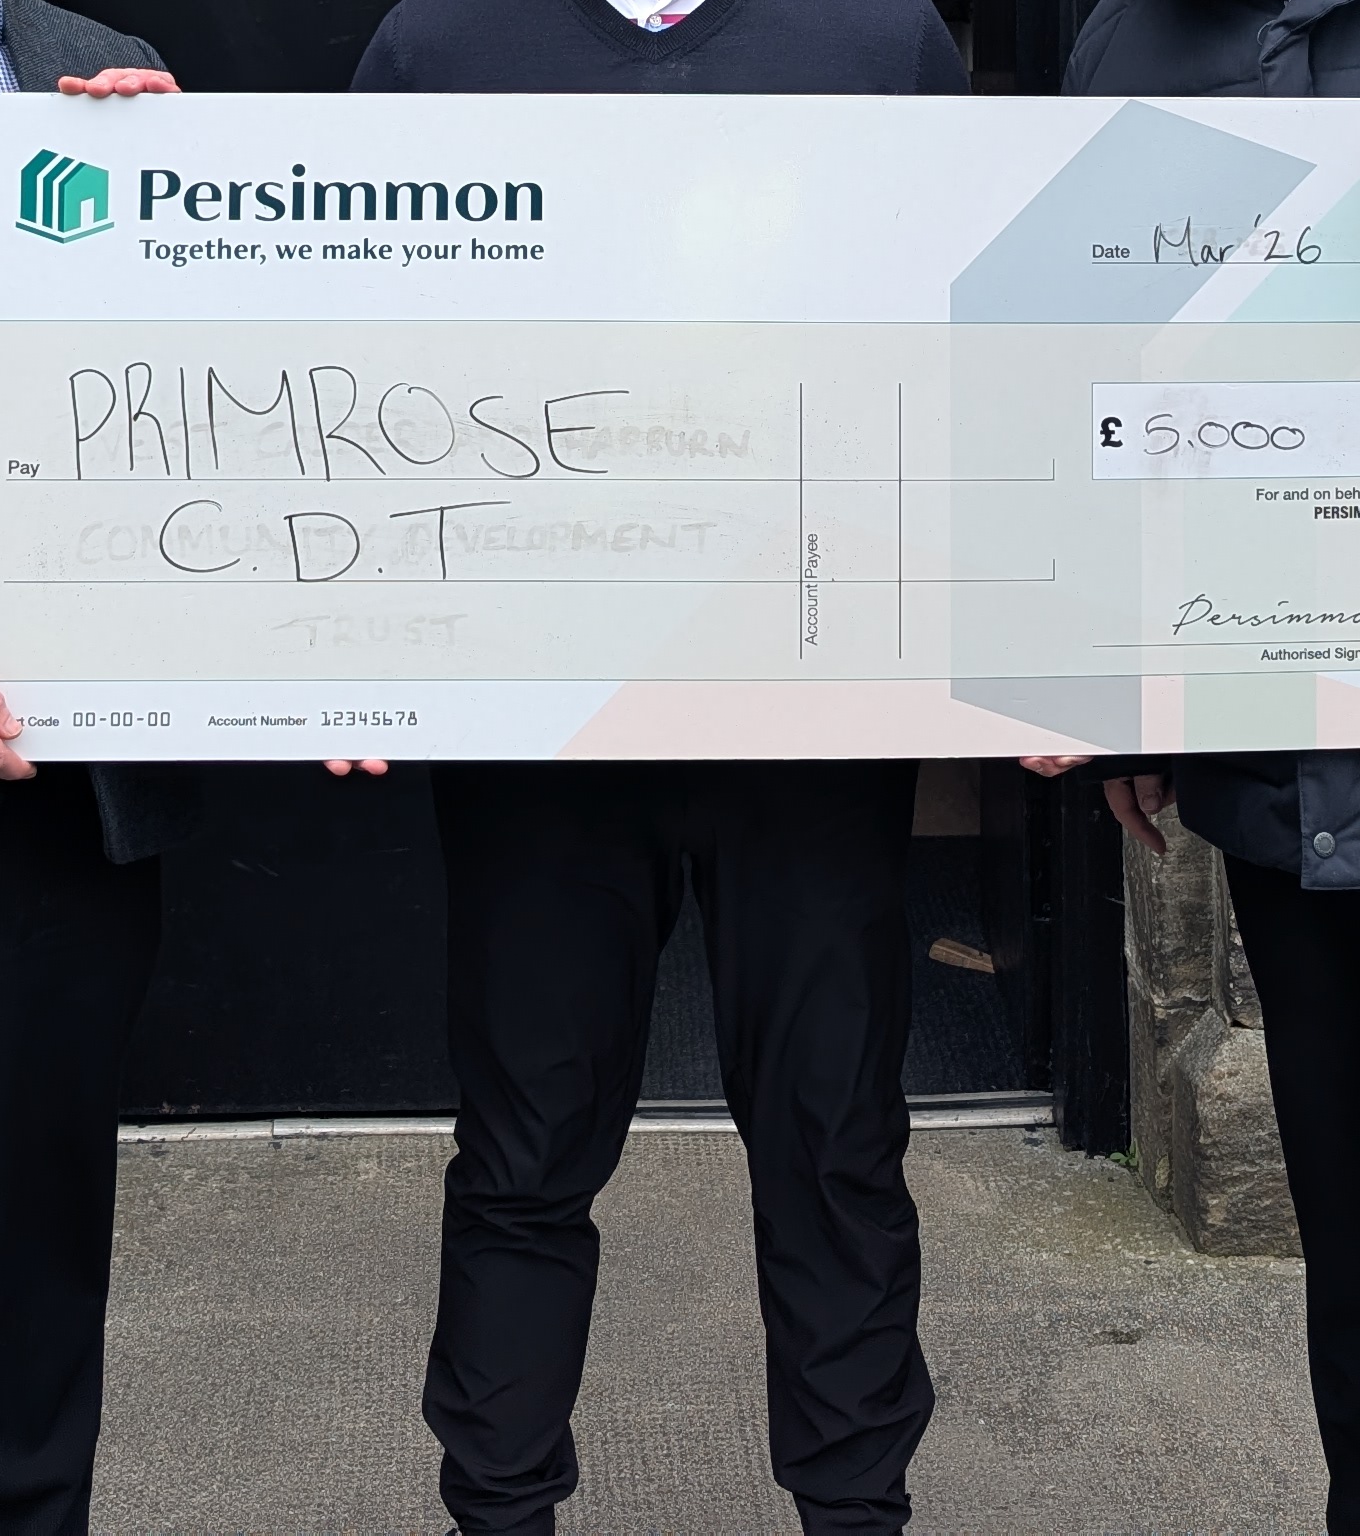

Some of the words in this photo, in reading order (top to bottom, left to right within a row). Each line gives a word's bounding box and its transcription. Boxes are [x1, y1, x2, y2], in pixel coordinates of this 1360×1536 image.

[140, 163, 543, 222] Persimmon
[139, 238, 267, 267] Together,
[275, 243, 313, 260] we
[322, 238, 393, 260] make
[401, 243, 462, 267] your
[471, 238, 545, 260] home
[1092, 244, 1131, 260] Date
[1153, 215, 1235, 267] Mar
[69, 362, 630, 481] PRIMROSE
[1099, 416, 1123, 448] £
[7, 459, 41, 479] Pay
[1256, 488, 1279, 501] For
[1282, 488, 1309, 501] and
[1313, 490, 1331, 500] on
[804, 533, 821, 579] Payee
[804, 583, 818, 646] Account
[1260, 648, 1330, 661] Authorised
[27, 715, 60, 728] Code
[72, 710, 171, 728] 00-00-00
[208, 715, 257, 727] Account
[259, 714, 308, 727] Number
[320, 710, 419, 727] 12345678
